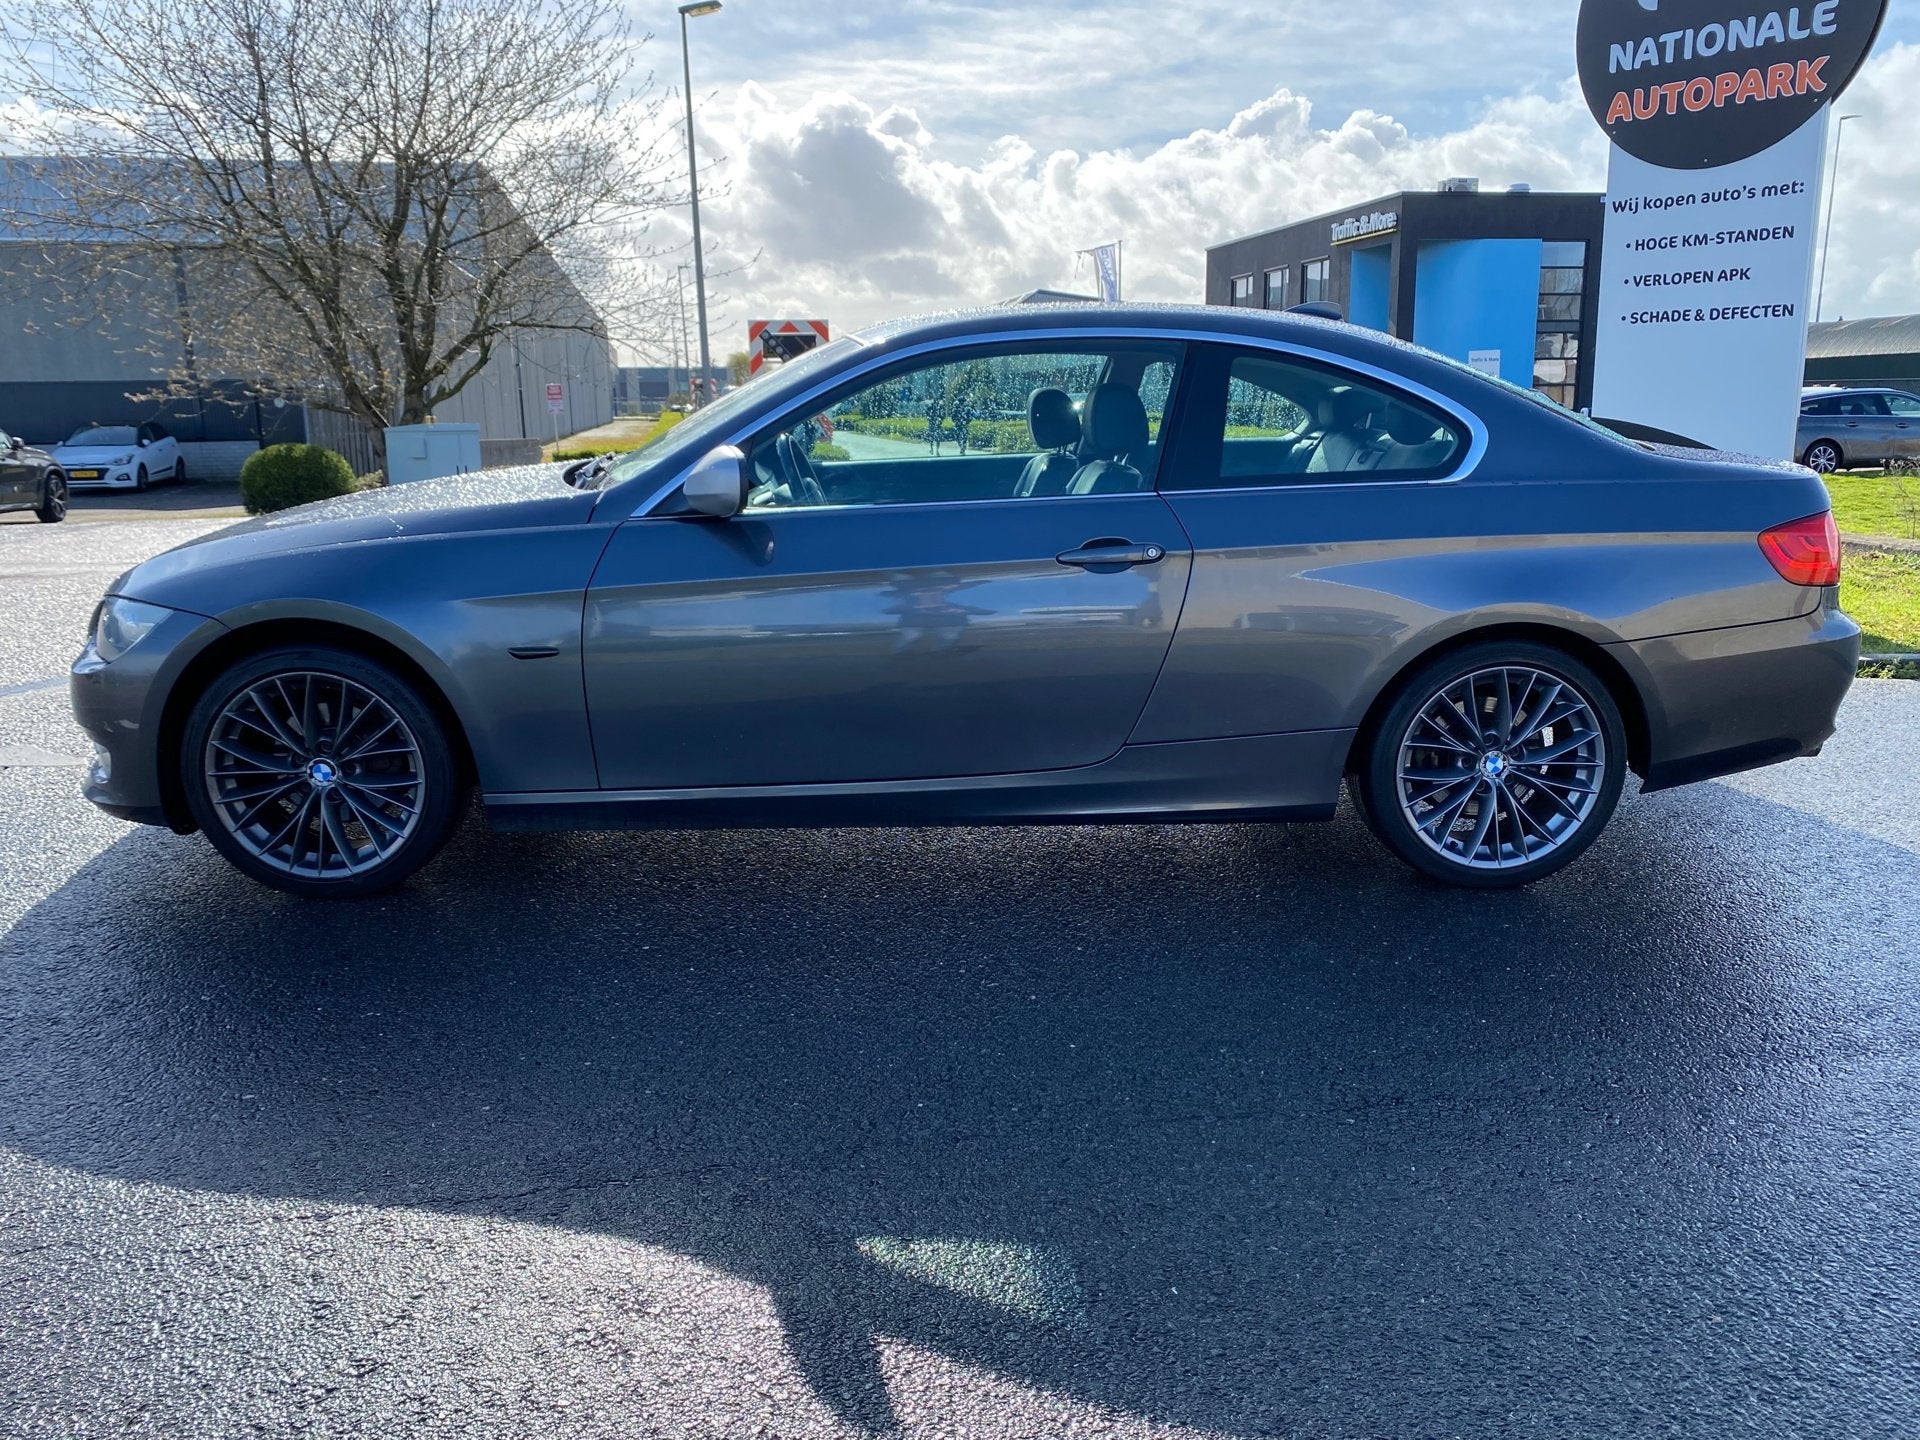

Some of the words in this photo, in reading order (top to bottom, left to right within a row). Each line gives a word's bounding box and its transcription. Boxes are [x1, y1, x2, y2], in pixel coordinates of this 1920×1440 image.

[1608, 0, 1839, 73] NATIONALE
[1606, 55, 1830, 124] AUTOPARK
[1612, 197, 1639, 214] Wij
[1643, 193, 1696, 210] kopen
[1700, 186, 1756, 204] auto's
[1761, 180, 1805, 197] met:
[1635, 236, 1678, 251] HOGE
[1682, 226, 1795, 247] KM-STANDEN
[1633, 270, 1714, 287] VERLOPEN
[1717, 267, 1751, 282] APK
[1630, 308, 1691, 324] SCHADE
[1694, 309, 1705, 321] &
[1709, 303, 1795, 321] DEFECTEN
